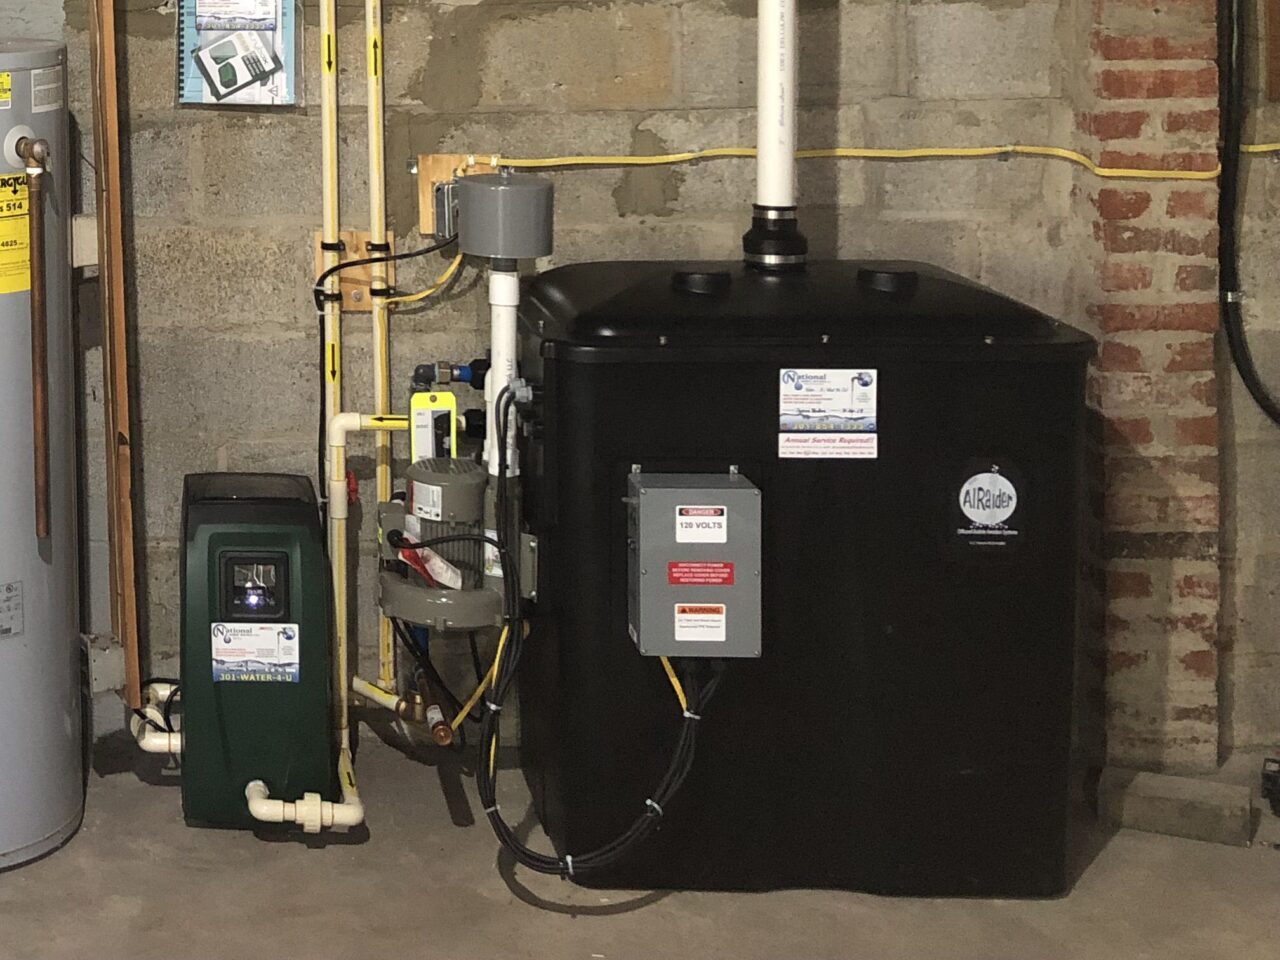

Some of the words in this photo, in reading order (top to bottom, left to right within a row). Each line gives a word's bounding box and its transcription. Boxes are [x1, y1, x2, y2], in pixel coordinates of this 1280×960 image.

[6, 202, 23, 211] 514
[783, 371, 827, 386] National
[213, 624, 253, 638] National
